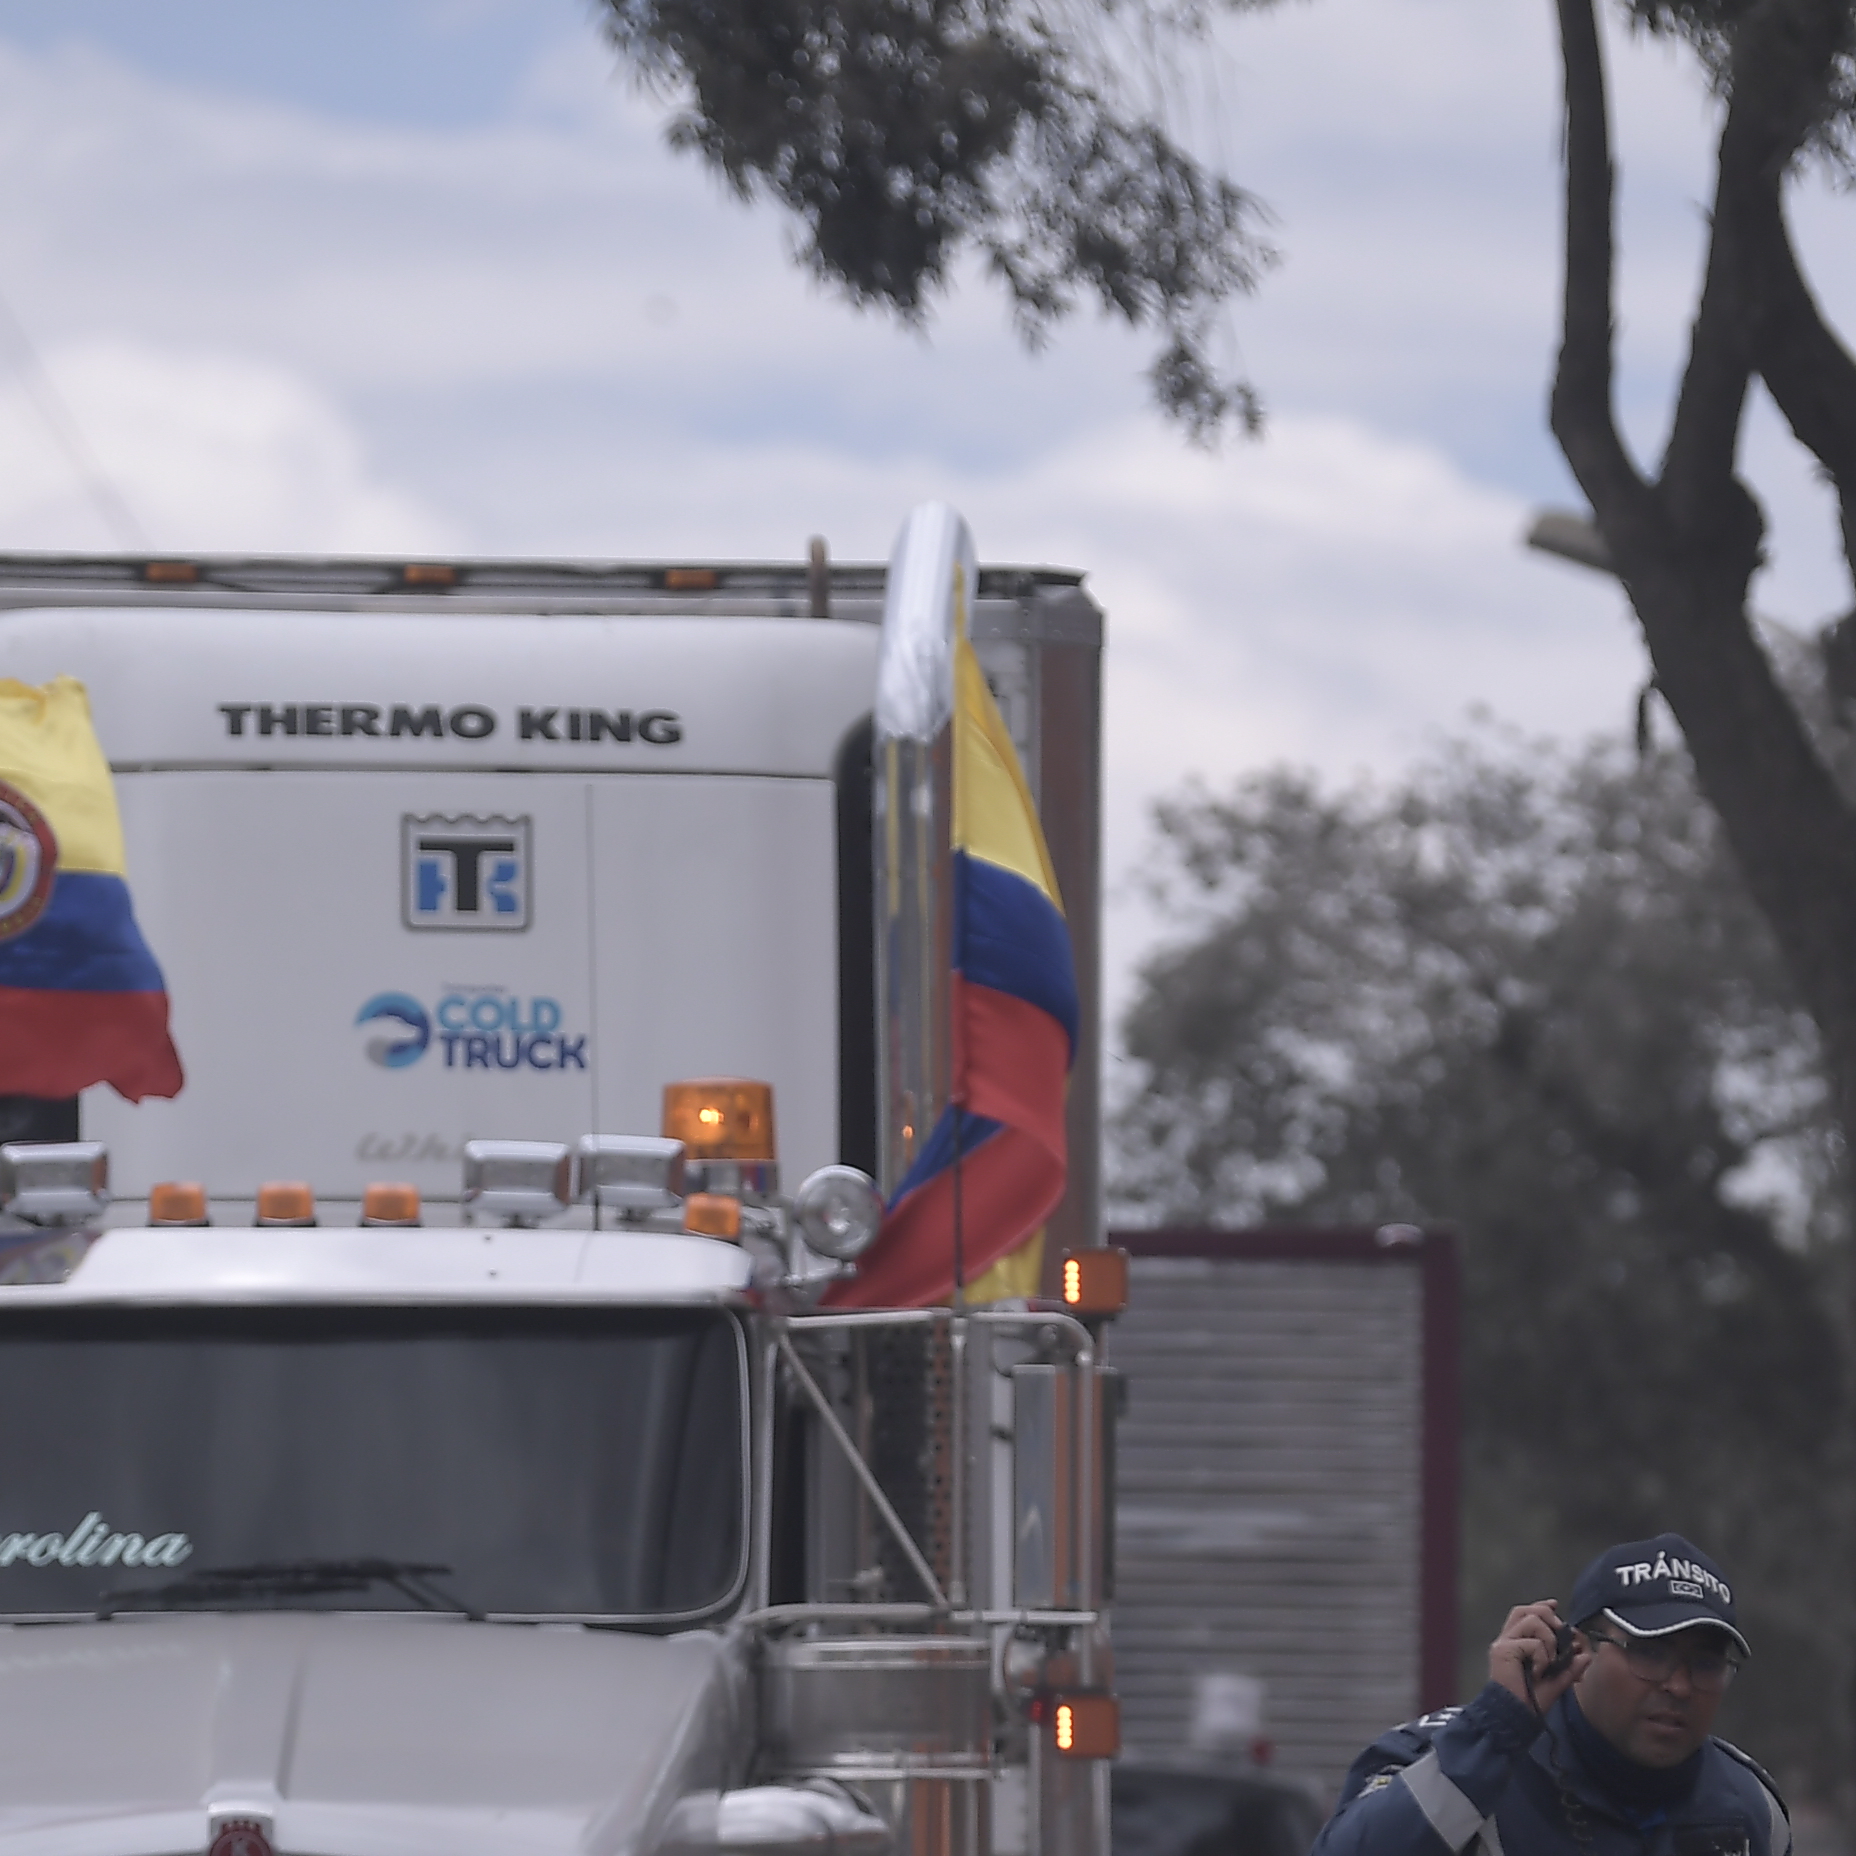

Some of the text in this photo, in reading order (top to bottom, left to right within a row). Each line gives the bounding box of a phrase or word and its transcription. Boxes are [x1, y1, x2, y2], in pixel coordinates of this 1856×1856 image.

[219, 704, 682, 745] THERMO KING
[437, 997, 562, 1033] COLD
[439, 1034, 588, 1070] TRUCK
[1615, 1551, 1732, 1604] TRÁNSITO
